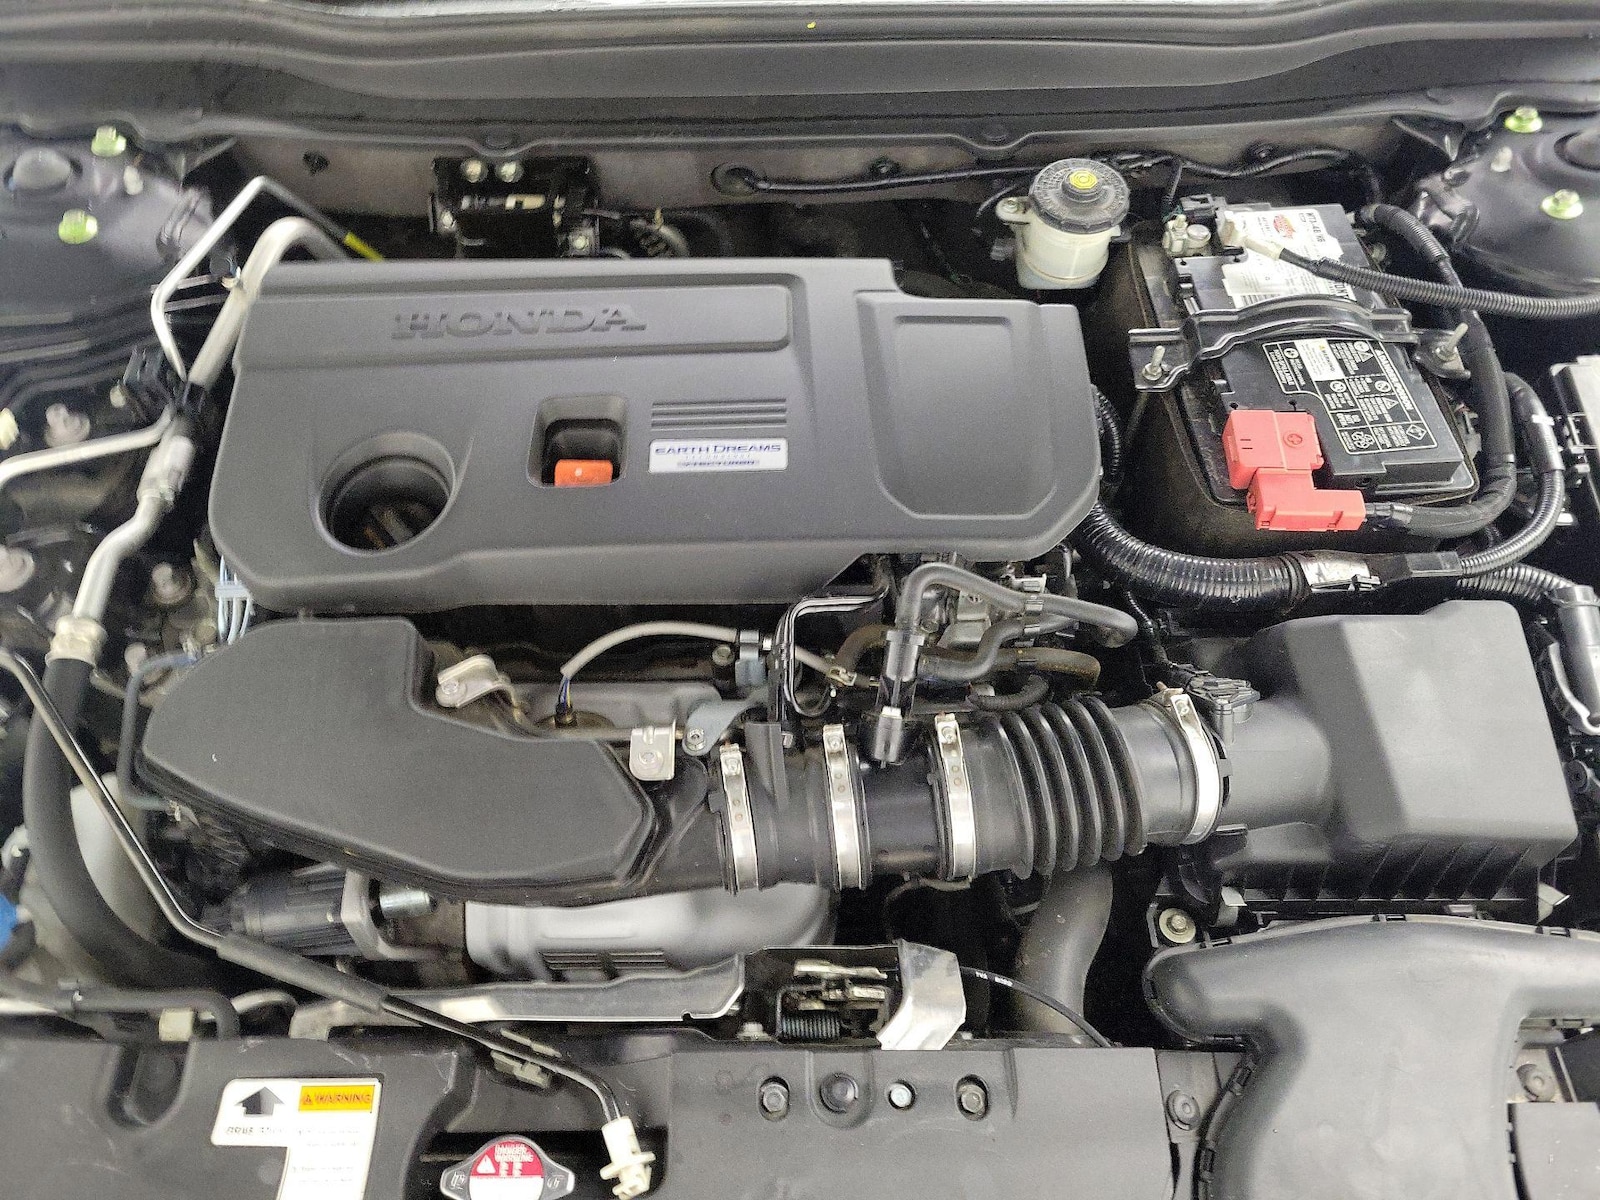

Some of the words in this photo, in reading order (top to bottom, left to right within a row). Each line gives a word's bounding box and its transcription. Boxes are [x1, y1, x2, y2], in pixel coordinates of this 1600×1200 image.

[391, 308, 647, 340] HONDA
[655, 445, 709, 455] EARTH
[713, 444, 781, 454] DREAMS
[314, 1092, 371, 1106] WARNING
